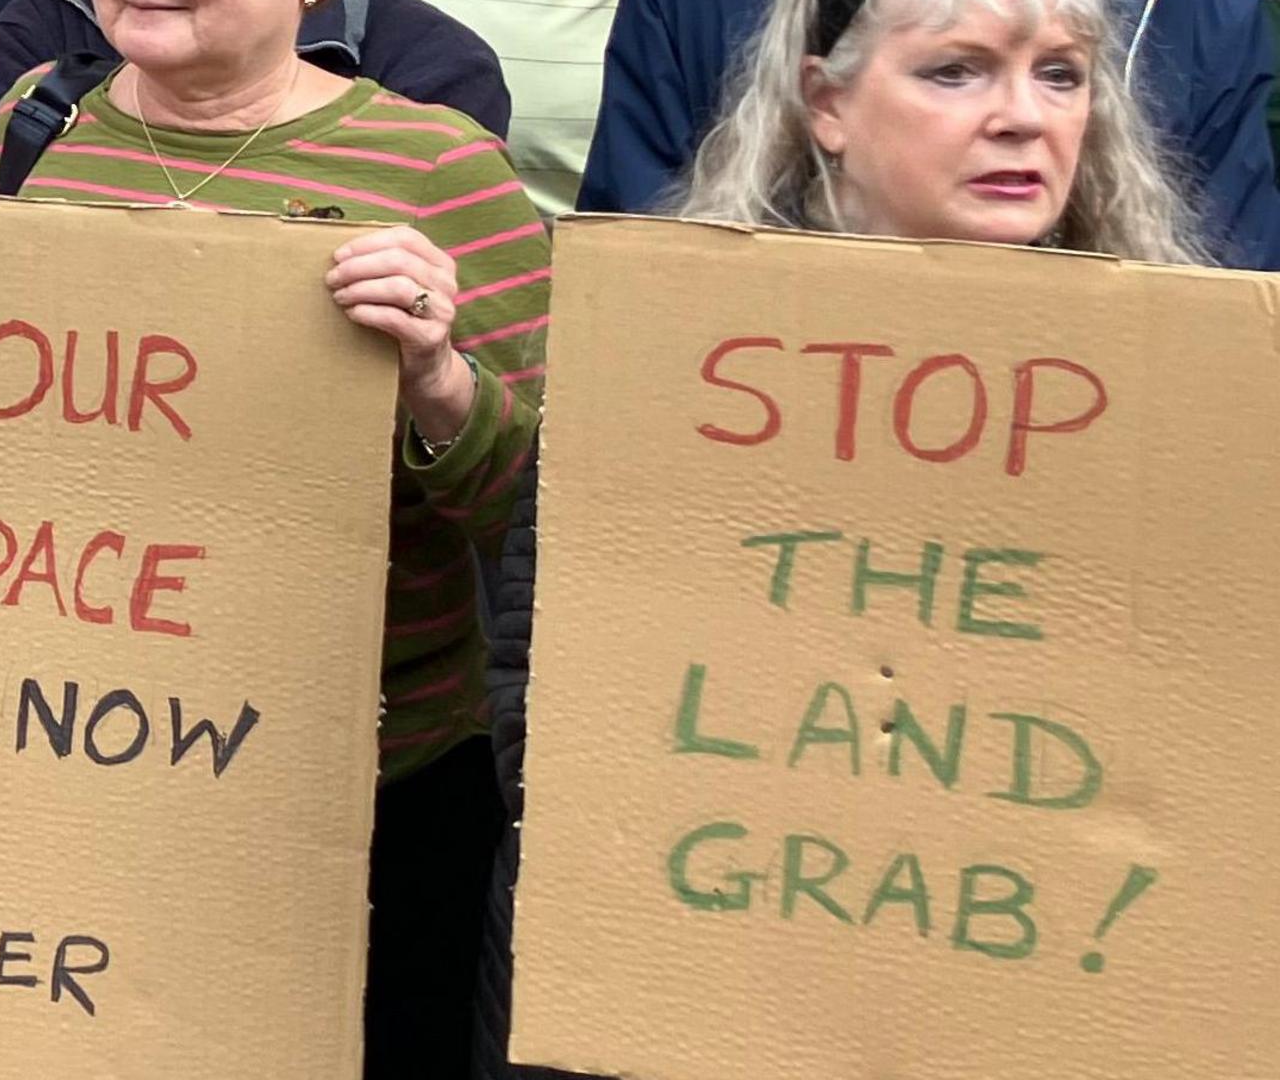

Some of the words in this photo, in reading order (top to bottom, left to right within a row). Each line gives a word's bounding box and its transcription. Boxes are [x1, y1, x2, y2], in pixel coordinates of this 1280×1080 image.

[694, 336, 1110, 478] STOP
[740, 530, 1046, 641] THE
[14, 677, 260, 779] NOW
[670, 662, 1105, 812] LAND
